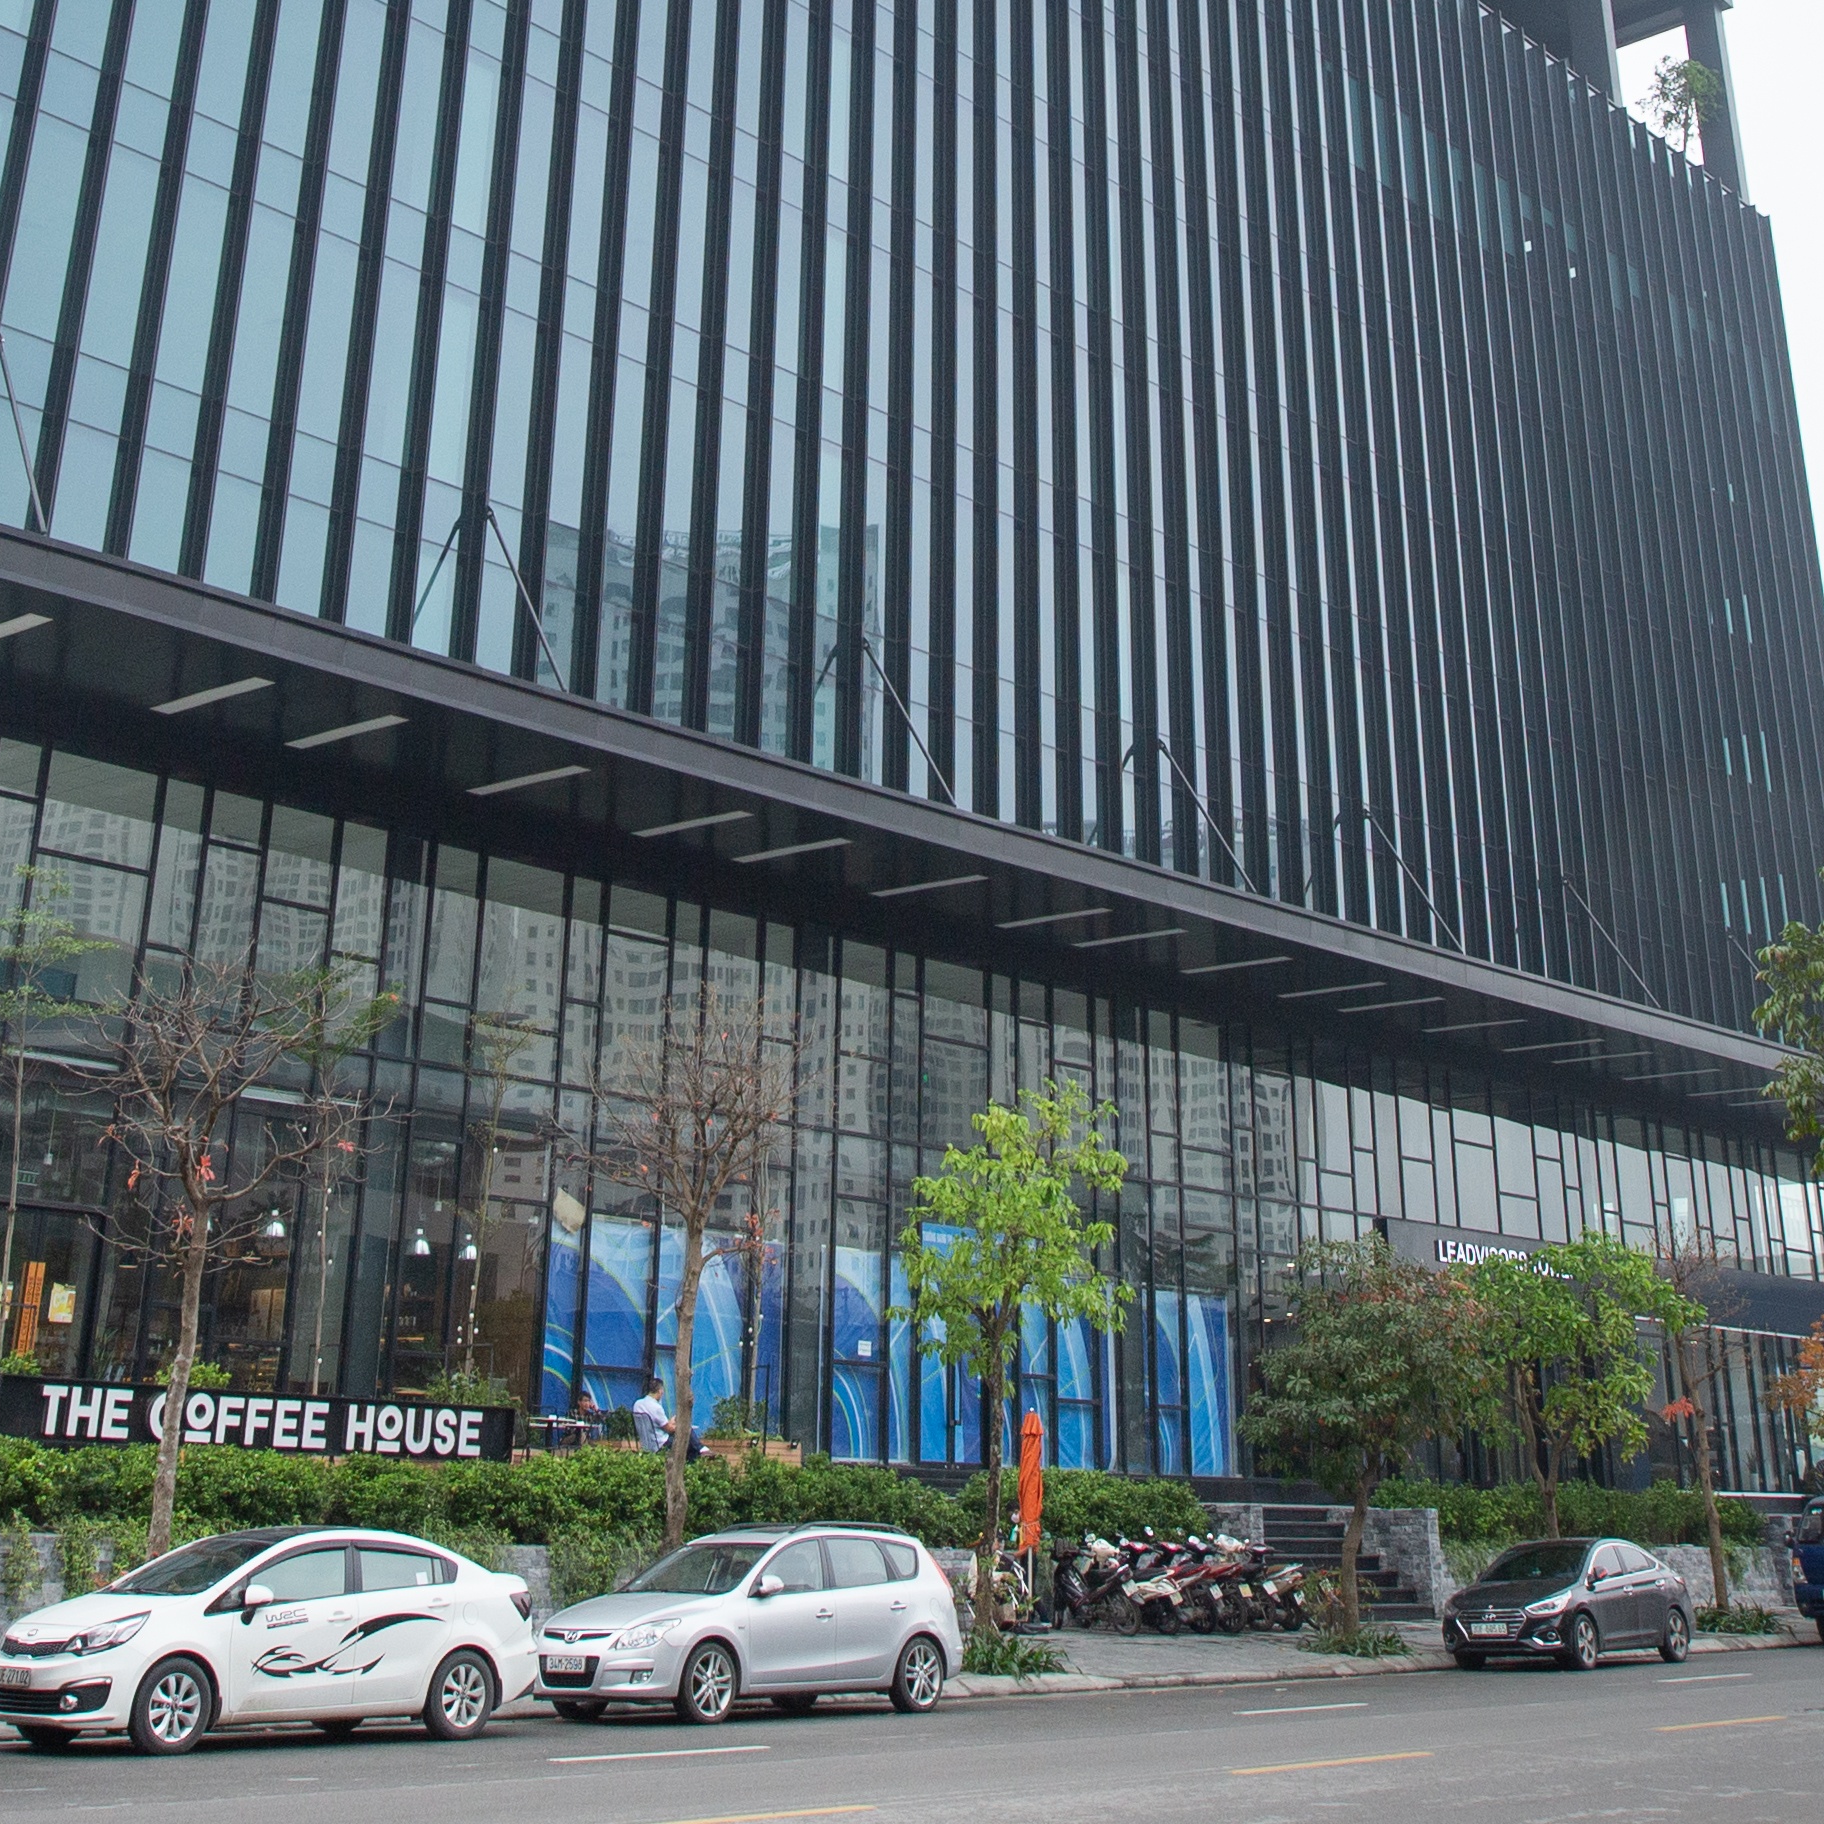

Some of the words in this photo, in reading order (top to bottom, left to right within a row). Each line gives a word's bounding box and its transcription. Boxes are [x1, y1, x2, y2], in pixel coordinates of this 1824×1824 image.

[42, 1384, 133, 1439] THE
[148, 1391, 329, 1451] COFFEE
[345, 1404, 483, 1457] HOUSE
[265, 1608, 307, 1623] WRC
